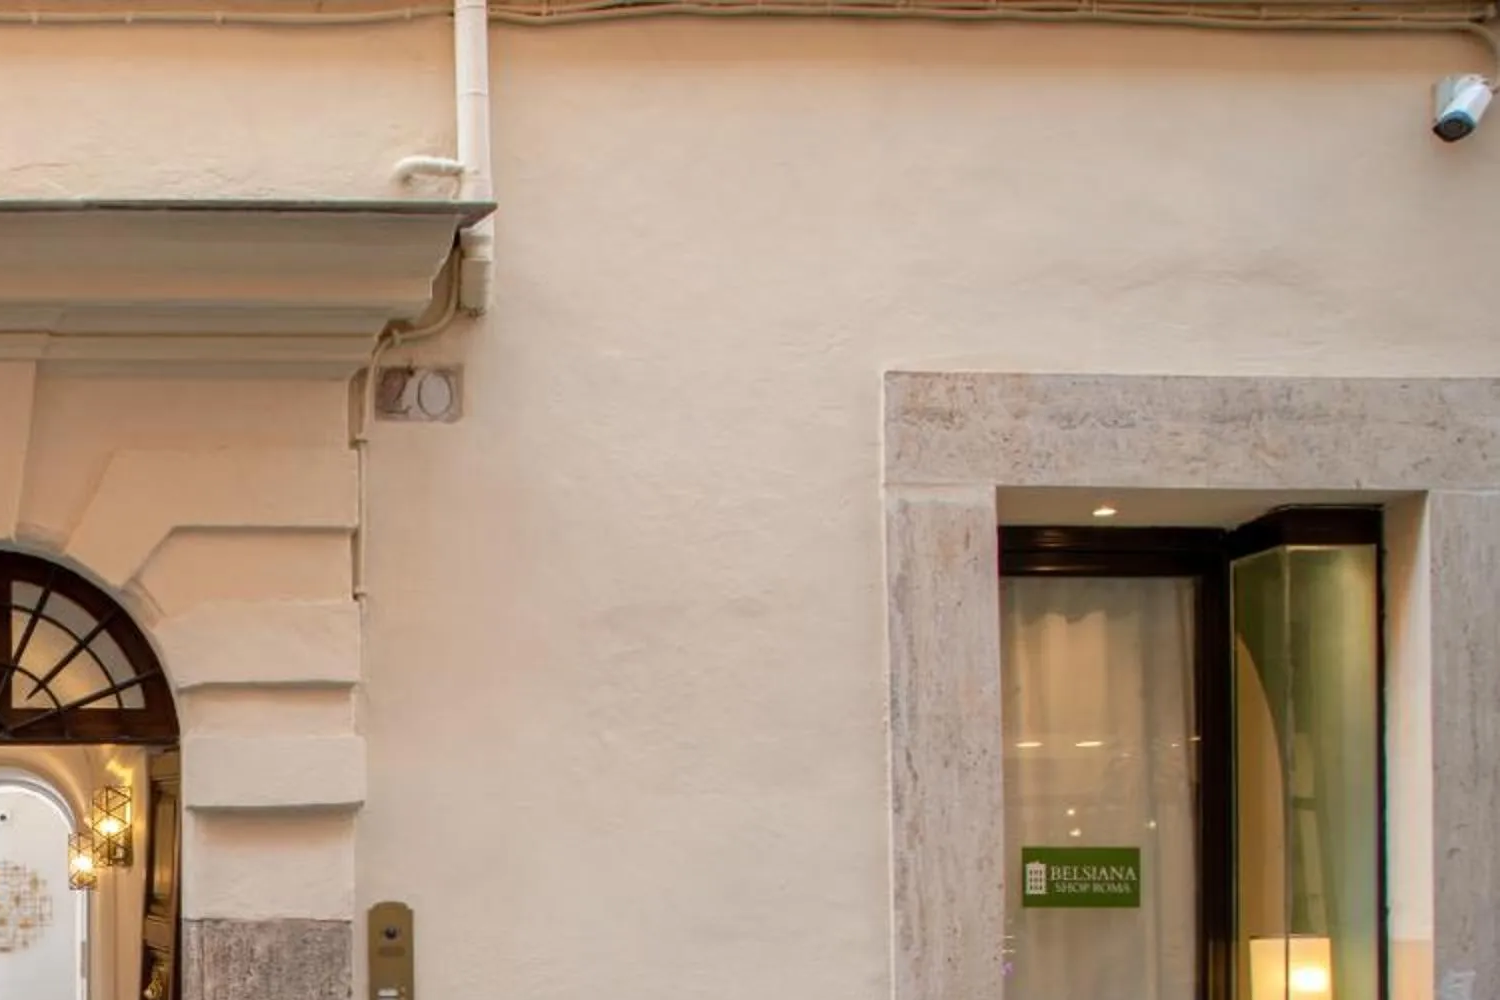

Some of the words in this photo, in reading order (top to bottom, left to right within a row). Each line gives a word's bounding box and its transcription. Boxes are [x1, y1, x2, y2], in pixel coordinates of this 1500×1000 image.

[1050, 865, 1138, 881] BELSIANA
[1054, 881, 1090, 894] SHOP
[1092, 881, 1133, 894] ROMA
